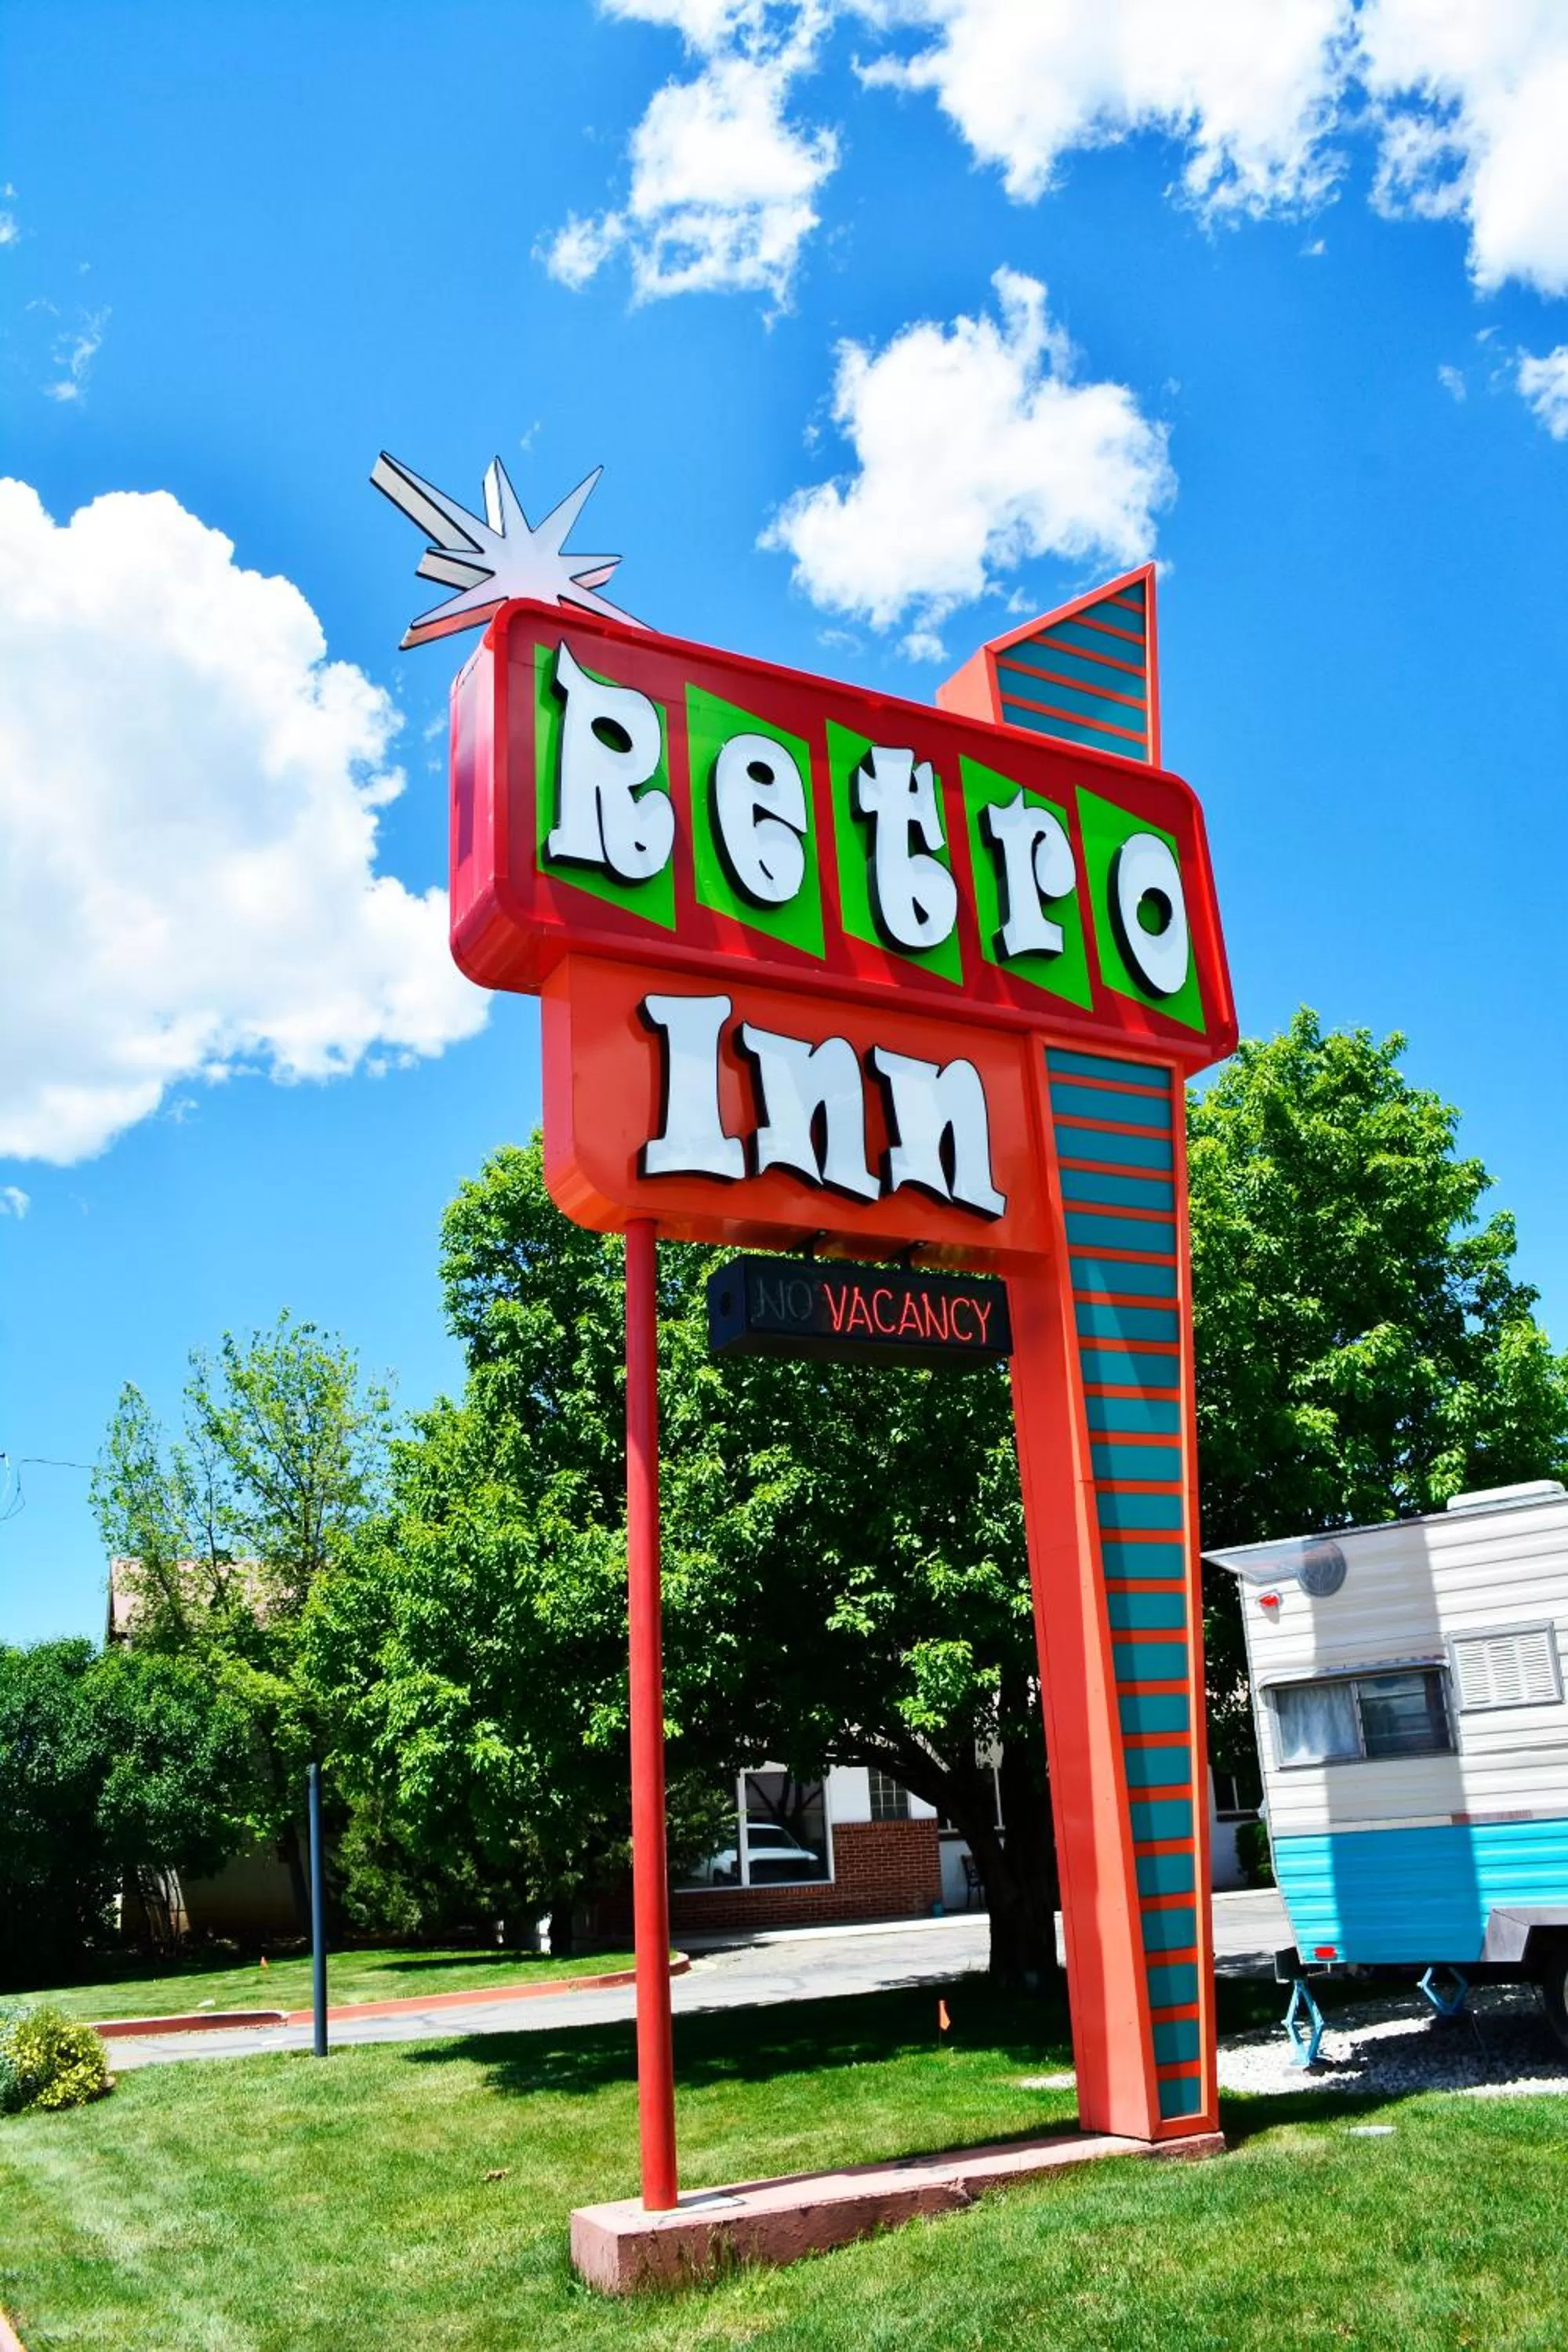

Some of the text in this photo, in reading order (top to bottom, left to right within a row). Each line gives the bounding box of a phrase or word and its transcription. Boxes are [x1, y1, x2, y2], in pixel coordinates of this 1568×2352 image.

[546, 640, 1189, 996] Retro
[639, 993, 1007, 1221] Inn
[753, 1278, 993, 1344] NO VACANCY
